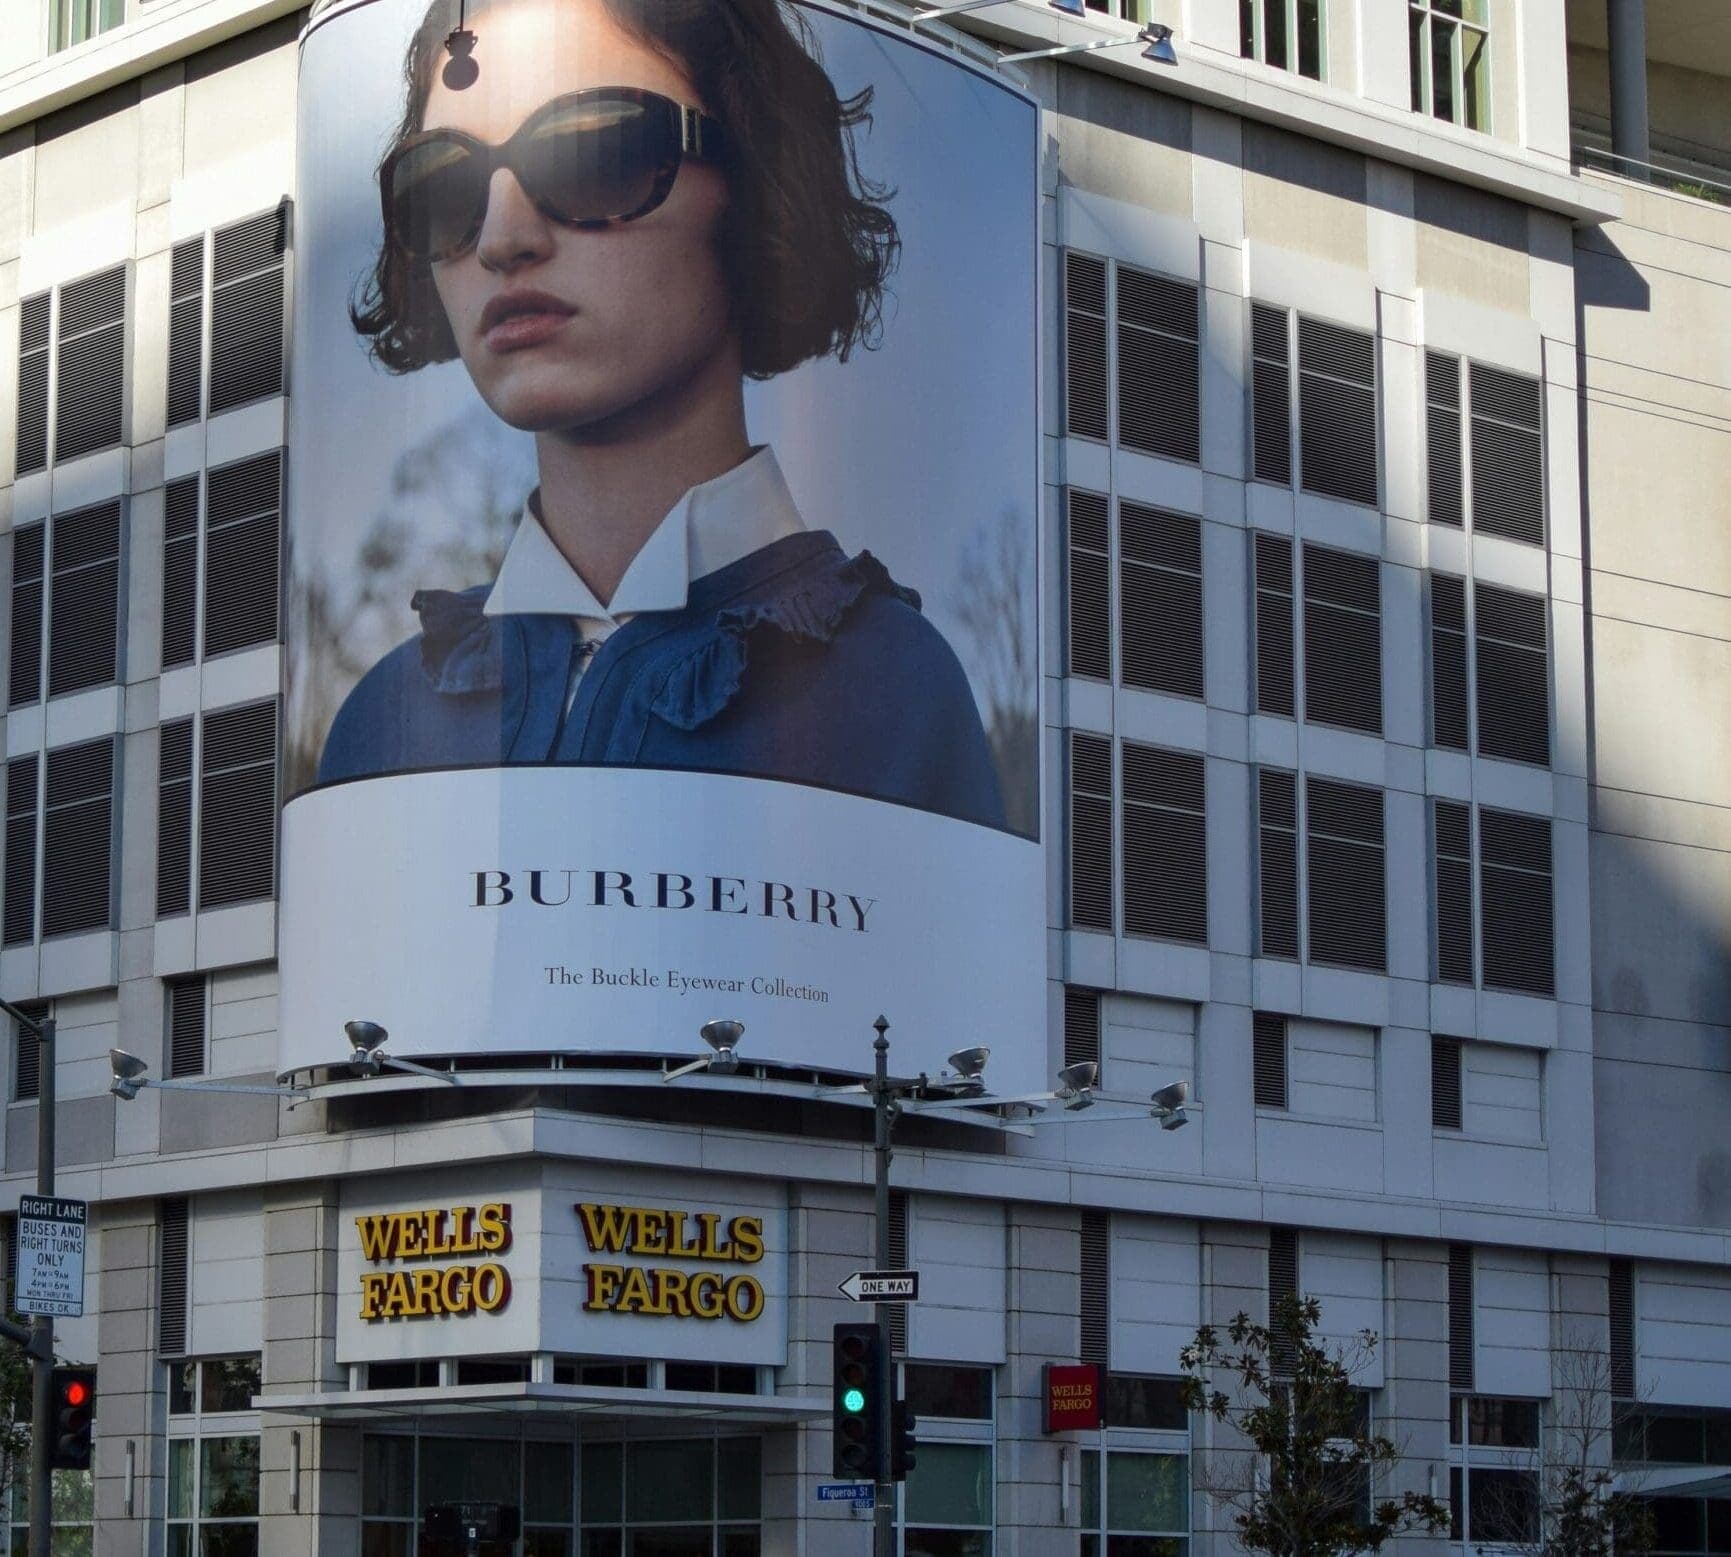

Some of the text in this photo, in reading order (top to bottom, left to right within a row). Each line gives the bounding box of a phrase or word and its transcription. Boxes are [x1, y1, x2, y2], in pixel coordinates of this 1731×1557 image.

[469, 869, 880, 933] BURBERRY
[544, 966, 830, 1004] The Buckle Eyewear Collection
[21, 1200, 84, 1219] RIGHT LANE
[23, 1220, 82, 1239] BUSES AND
[355, 1203, 512, 1261] WELLS
[575, 1203, 764, 1263] WELLS
[21, 1235, 82, 1254] RIGHT TURNS
[37, 1252, 65, 1268] ONLY
[359, 1262, 512, 1320] FARGO
[582, 1263, 765, 1322] FARGO
[861, 1279, 911, 1293] ONE WAY
[29, 1301, 55, 1312] BIKES
[57, 1303, 69, 1313] OK
[1051, 1384, 1093, 1397] WELLS
[1052, 1398, 1092, 1411] FARGO
[822, 1486, 868, 1500] Figueroa St
